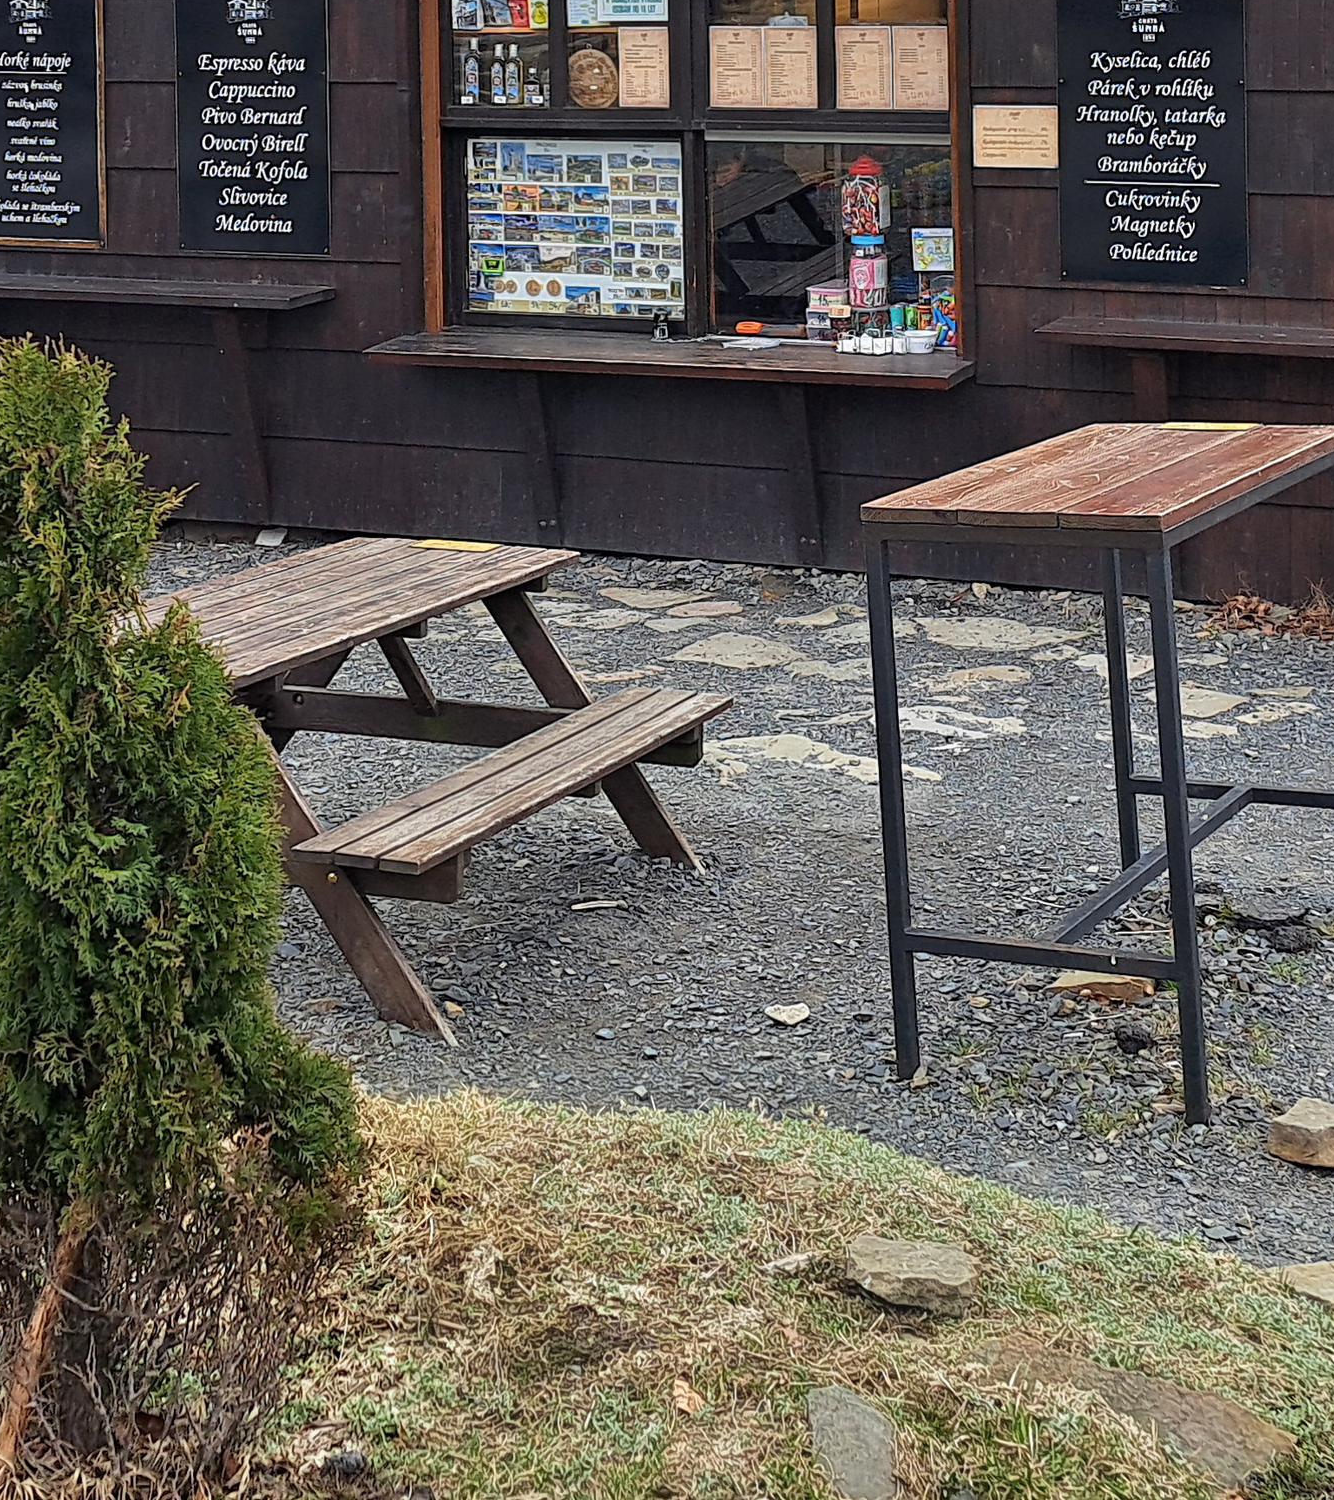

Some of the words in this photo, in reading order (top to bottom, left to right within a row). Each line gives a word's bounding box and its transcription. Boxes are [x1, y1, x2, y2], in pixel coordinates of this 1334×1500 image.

[32, 52, 72, 72] nápoje
[197, 53, 264, 77] Espresso
[267, 51, 307, 75] káva
[1090, 51, 1163, 73] Kyselica,
[1168, 50, 1212, 69] chléb
[208, 80, 297, 104] Cappuccino
[1087, 78, 1140, 100] Párek
[1139, 84, 1151, 96] v
[1155, 78, 1215, 101] rohlíku
[201, 105, 237, 125] Pivo
[240, 106, 307, 125] Bernard
[1076, 104, 1158, 128] Hranolky,
[1164, 106, 1227, 128] tatarka
[201, 133, 259, 157] Ovocný
[261, 132, 309, 152] Birell
[1107, 127, 1145, 145] nebo
[1149, 127, 1197, 151] kečup
[198, 159, 251, 178] Točená
[255, 160, 309, 185] Kofola
[1097, 154, 1207, 180] Bramboráčky
[218, 185, 289, 206] Slivovice
[1105, 188, 1201, 214] Cukrovinky
[215, 212, 293, 233] Medovina
[1110, 215, 1196, 239] Magnetky
[1109, 243, 1199, 263] Pohlednice
